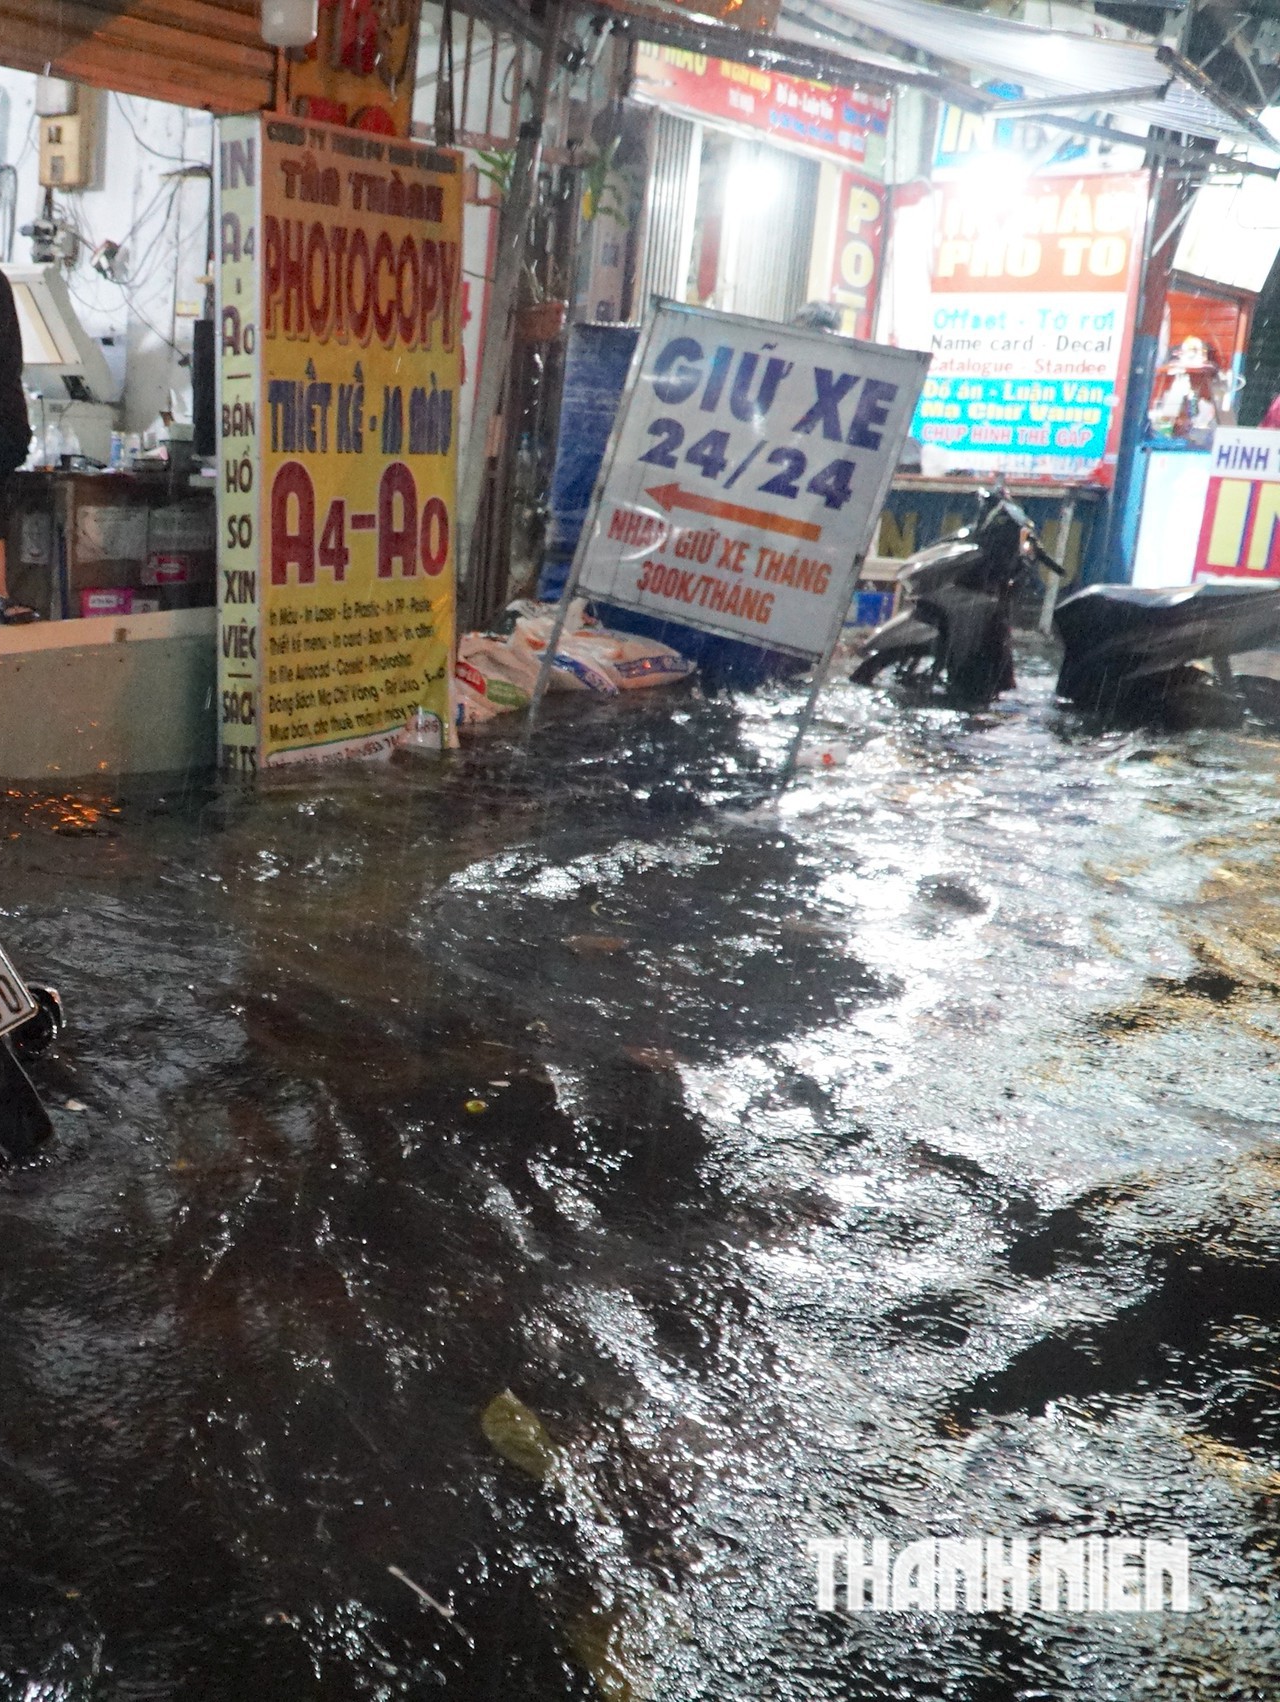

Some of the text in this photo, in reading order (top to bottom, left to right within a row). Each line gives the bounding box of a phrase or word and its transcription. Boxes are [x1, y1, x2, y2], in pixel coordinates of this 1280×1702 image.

[221, 137, 255, 190] IN
[1057, 235, 1128, 277] TO
[264, 215, 458, 350] PHOTOCOPY
[932, 308, 1008, 331] Offset
[926, 355, 1108, 376] Catalogue Standee
[930, 334, 1113, 353] Name card Decal
[651, 336, 900, 451] GIỮ XE
[222, 394, 256, 438] BÁN
[637, 417, 858, 511] 24/24
[1216, 438, 1270, 472] HÌNH
[223, 570, 256, 605] XIN
[716, 536, 751, 574] XE
[754, 549, 833, 596] THÁNG
[636, 560, 776, 625] 300K/THÁNG
